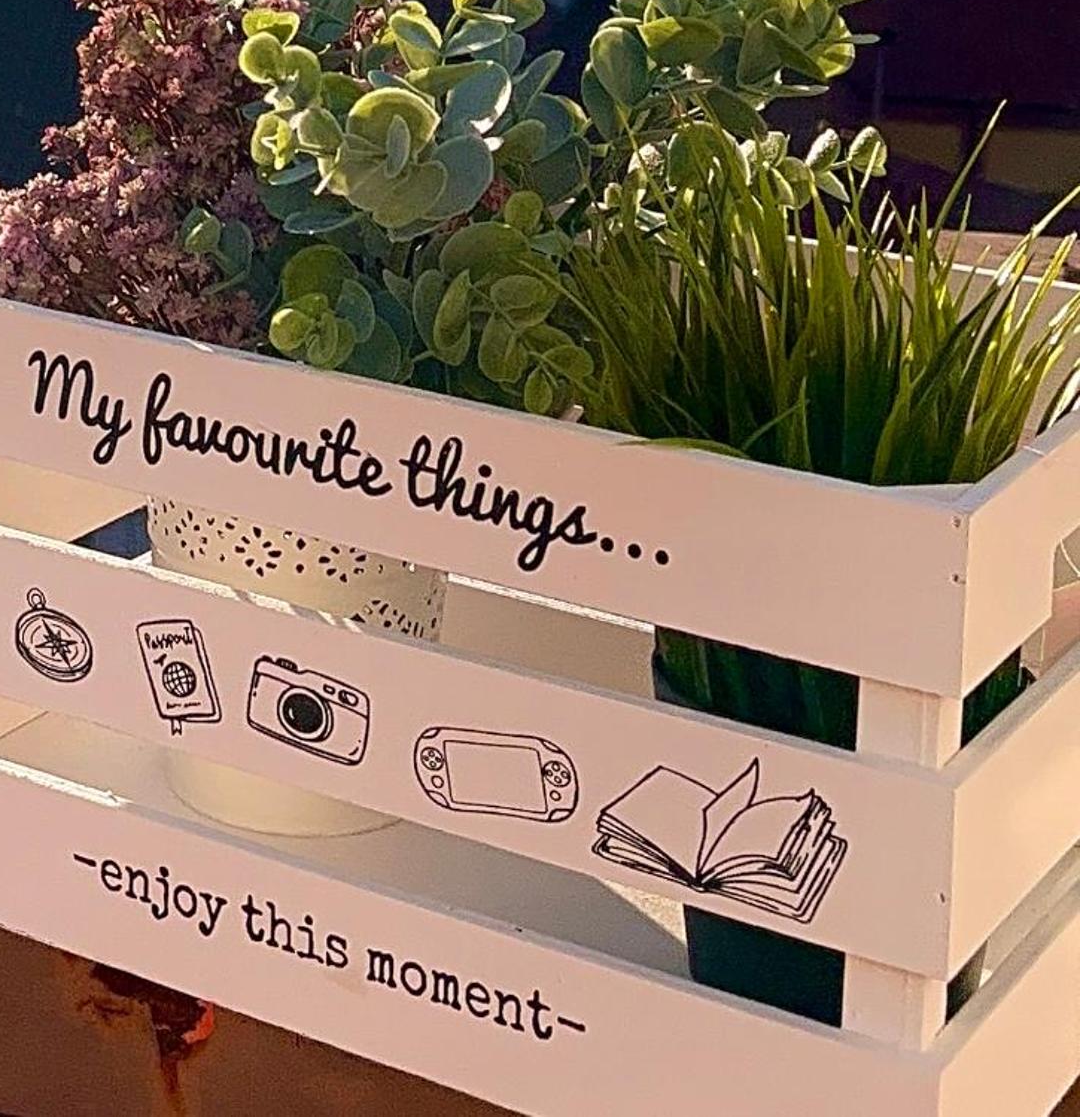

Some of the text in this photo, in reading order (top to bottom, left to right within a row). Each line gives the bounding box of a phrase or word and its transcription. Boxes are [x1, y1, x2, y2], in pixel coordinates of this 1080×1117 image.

[28, 350, 669, 572] My favourite things...
[73, 853, 586, 1040] -enjoy this moment-
